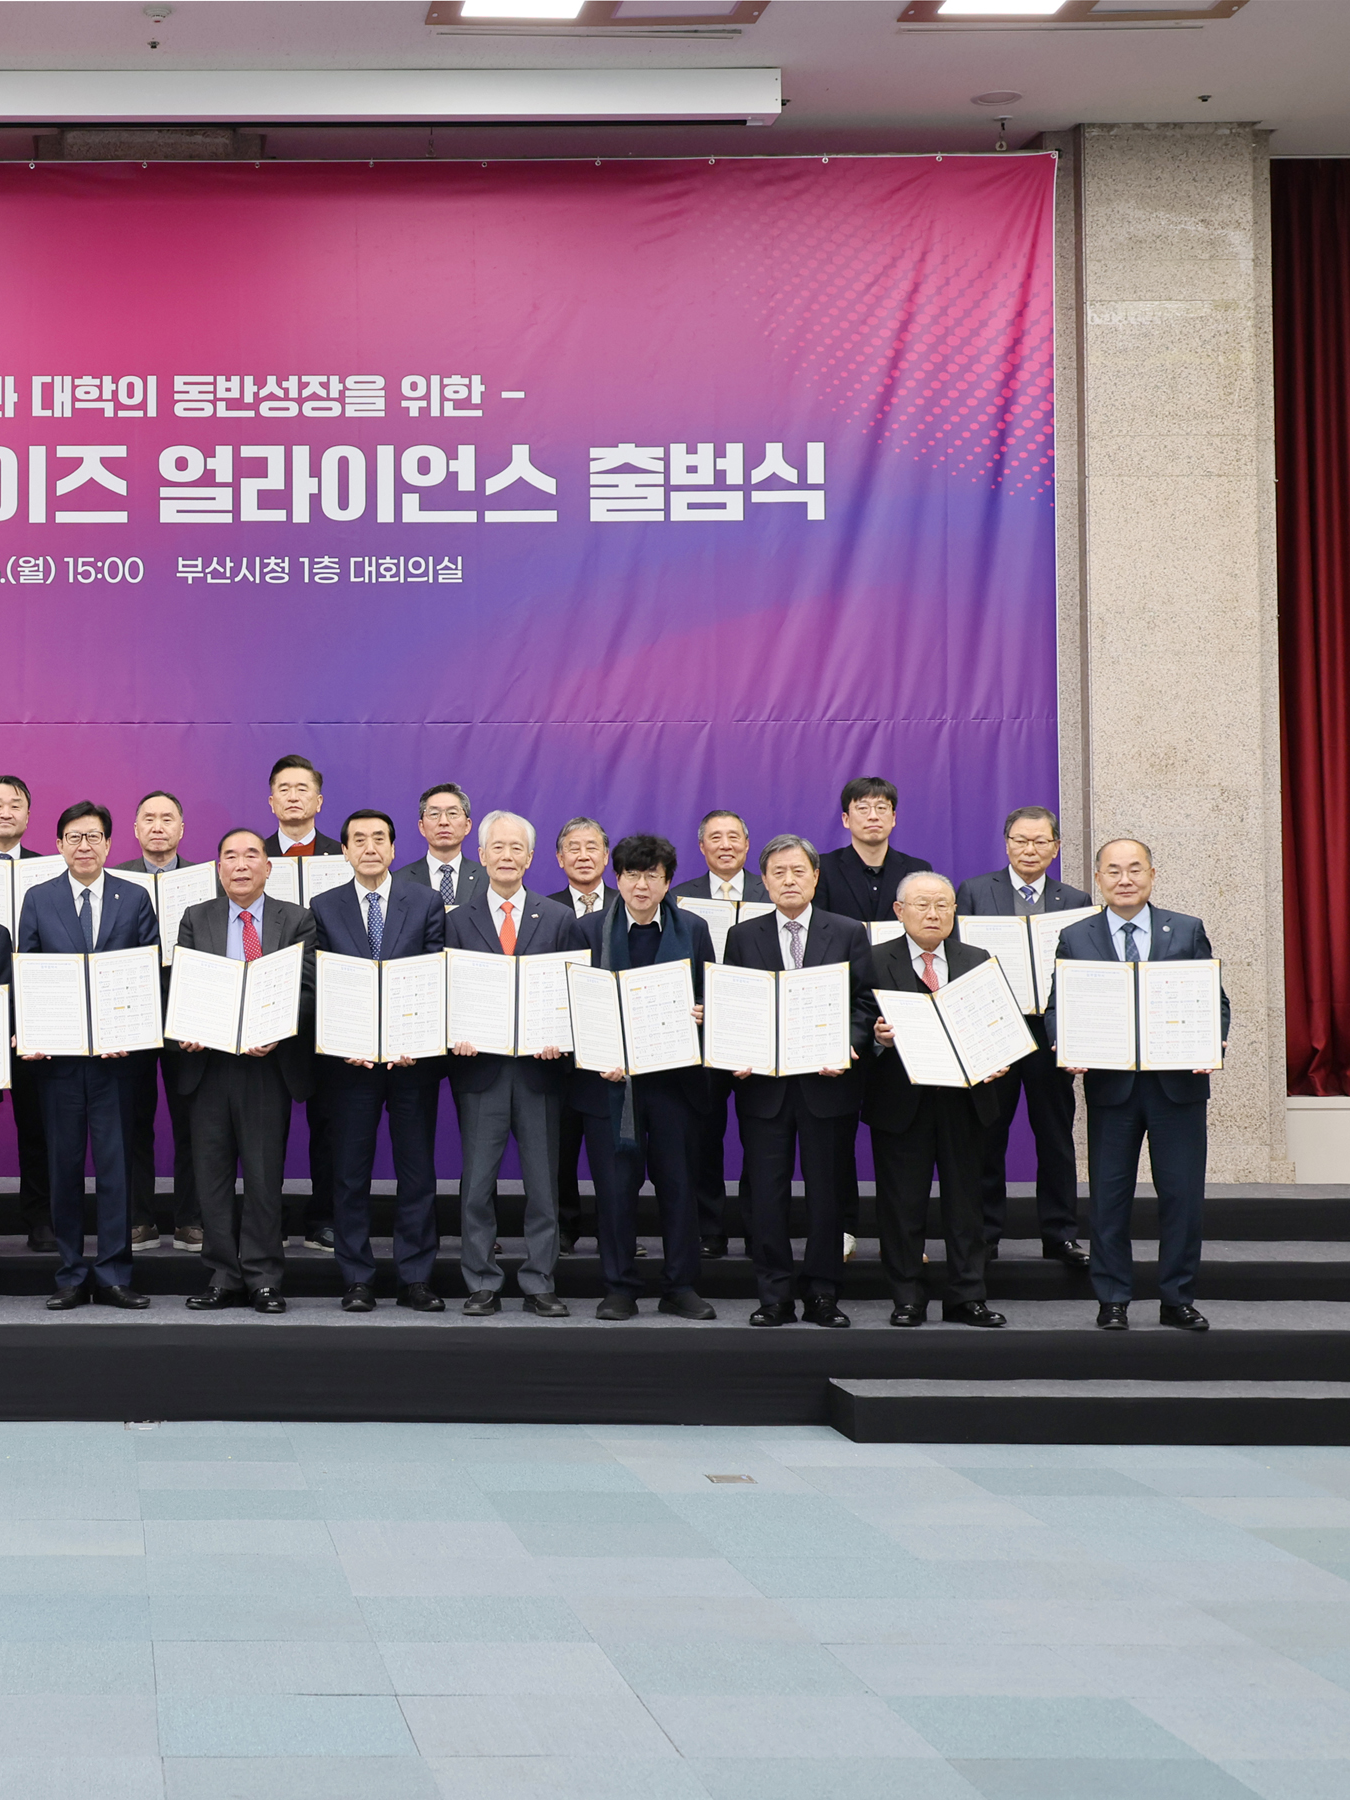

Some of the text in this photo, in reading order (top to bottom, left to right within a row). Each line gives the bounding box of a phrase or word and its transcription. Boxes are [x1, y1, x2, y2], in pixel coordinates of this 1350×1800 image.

[31, 375, 157, 418] 대학의
[173, 375, 386, 418] 동반성장을
[400, 374, 486, 417] 위한
[158, 444, 558, 524] 얼라이언스
[589, 441, 825, 522] 출범식
[63, 556, 144, 584] 15:00
[176, 556, 290, 584] 부산시청
[299, 555, 341, 584] 1층
[350, 556, 463, 584] 대회의실
